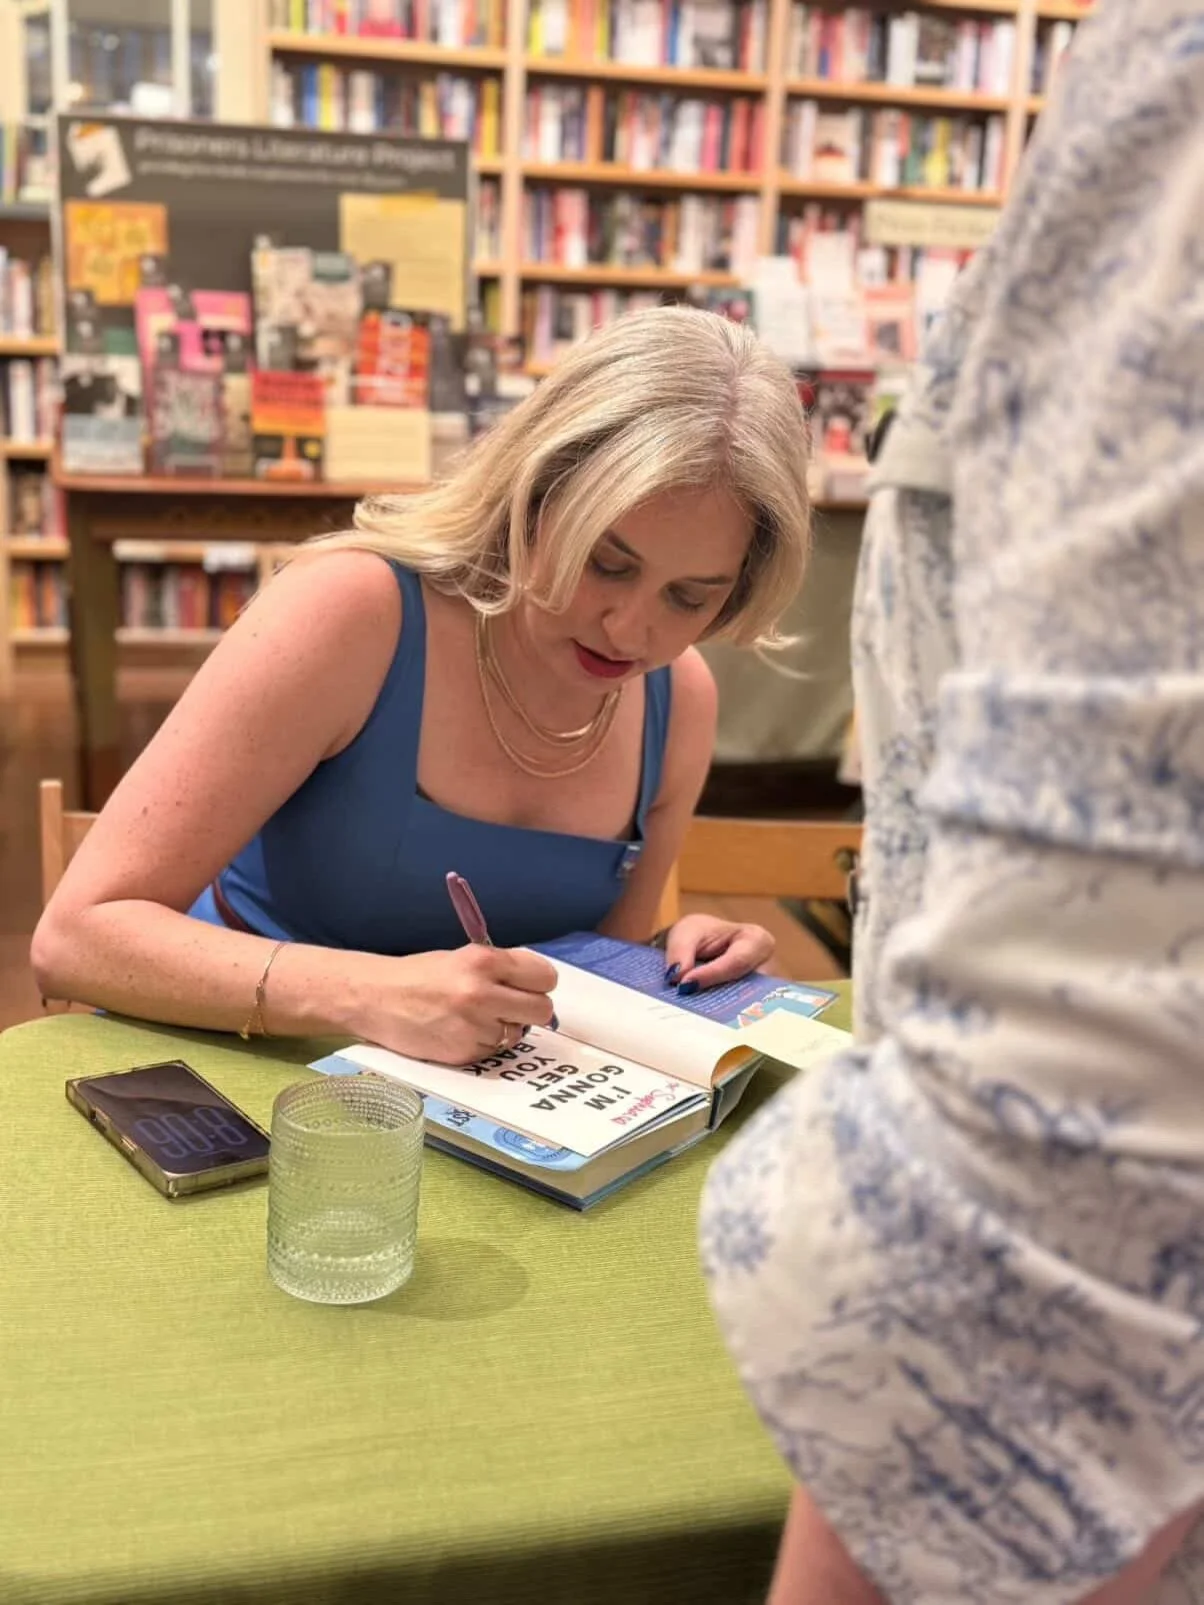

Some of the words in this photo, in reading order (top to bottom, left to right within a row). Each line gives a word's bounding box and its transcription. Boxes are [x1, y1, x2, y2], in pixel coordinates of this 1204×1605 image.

[133, 126, 249, 161] Prisoners
[252, 135, 370, 168] Literature
[373, 142, 457, 175] Project
[464, 1042, 537, 1077] BACK
[499, 1055, 556, 1082] YOU
[527, 1064, 579, 1092] GET
[529, 1065, 625, 1112] GONNA
[584, 1086, 632, 1111] I'M
[135, 1106, 248, 1158] 8:06
